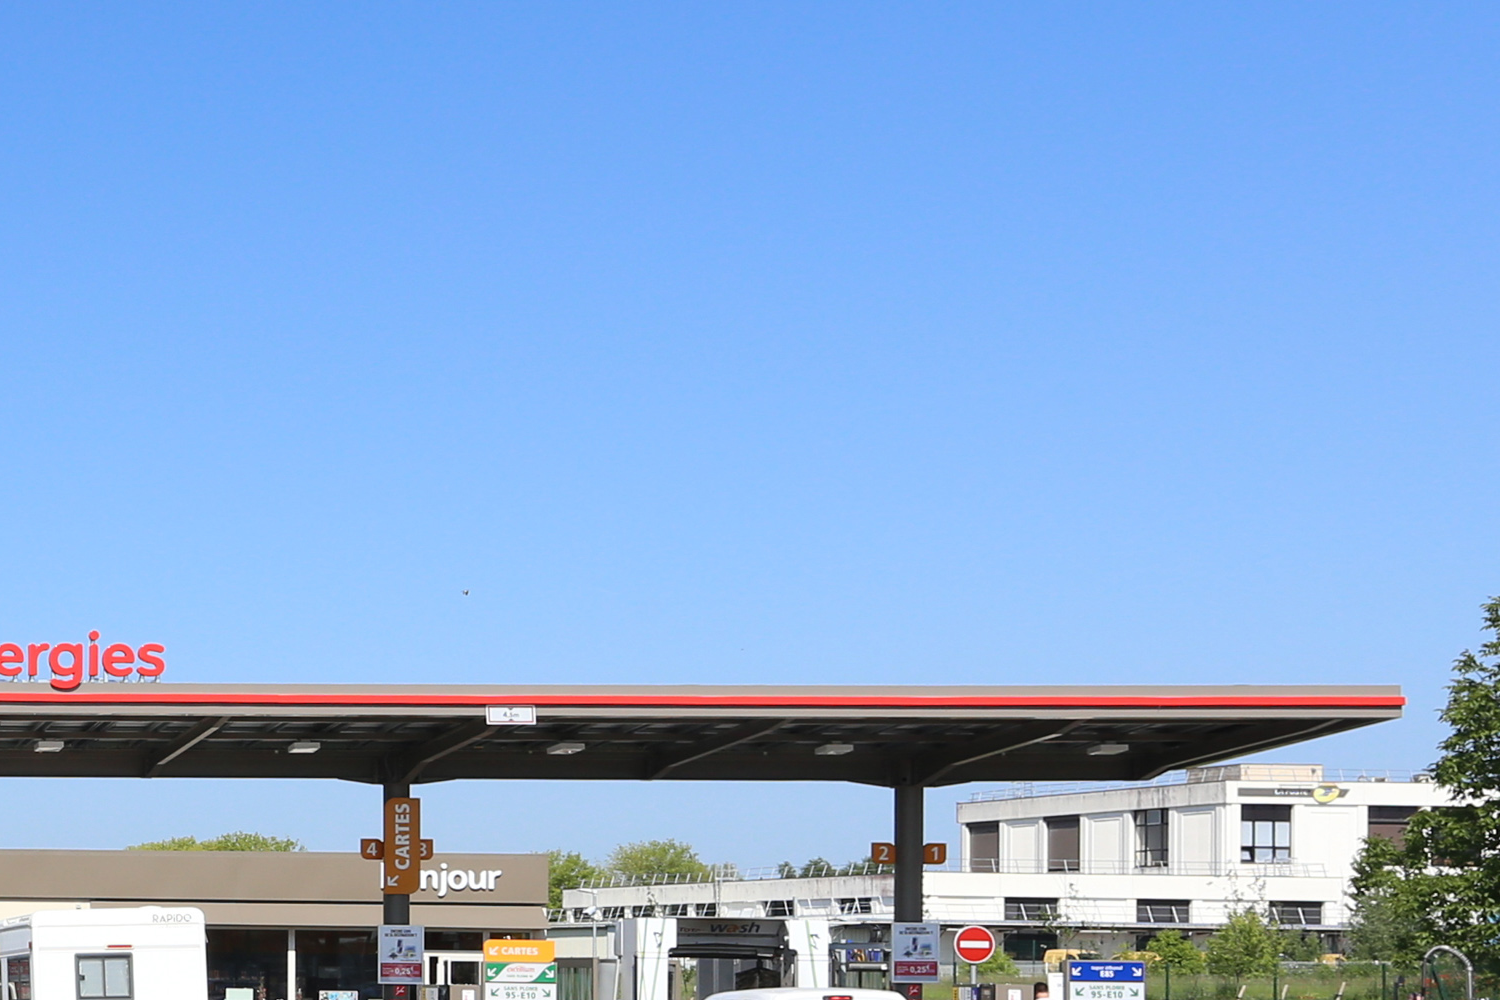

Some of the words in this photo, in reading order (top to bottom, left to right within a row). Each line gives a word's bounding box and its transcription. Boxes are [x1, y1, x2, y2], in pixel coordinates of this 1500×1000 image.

[394, 803, 410, 870] CARTES
[366, 842, 378, 856] 4
[878, 845, 890, 861] 2
[930, 846, 939, 861] 1
[709, 921, 761, 933] wash
[501, 946, 539, 956] CARTES
